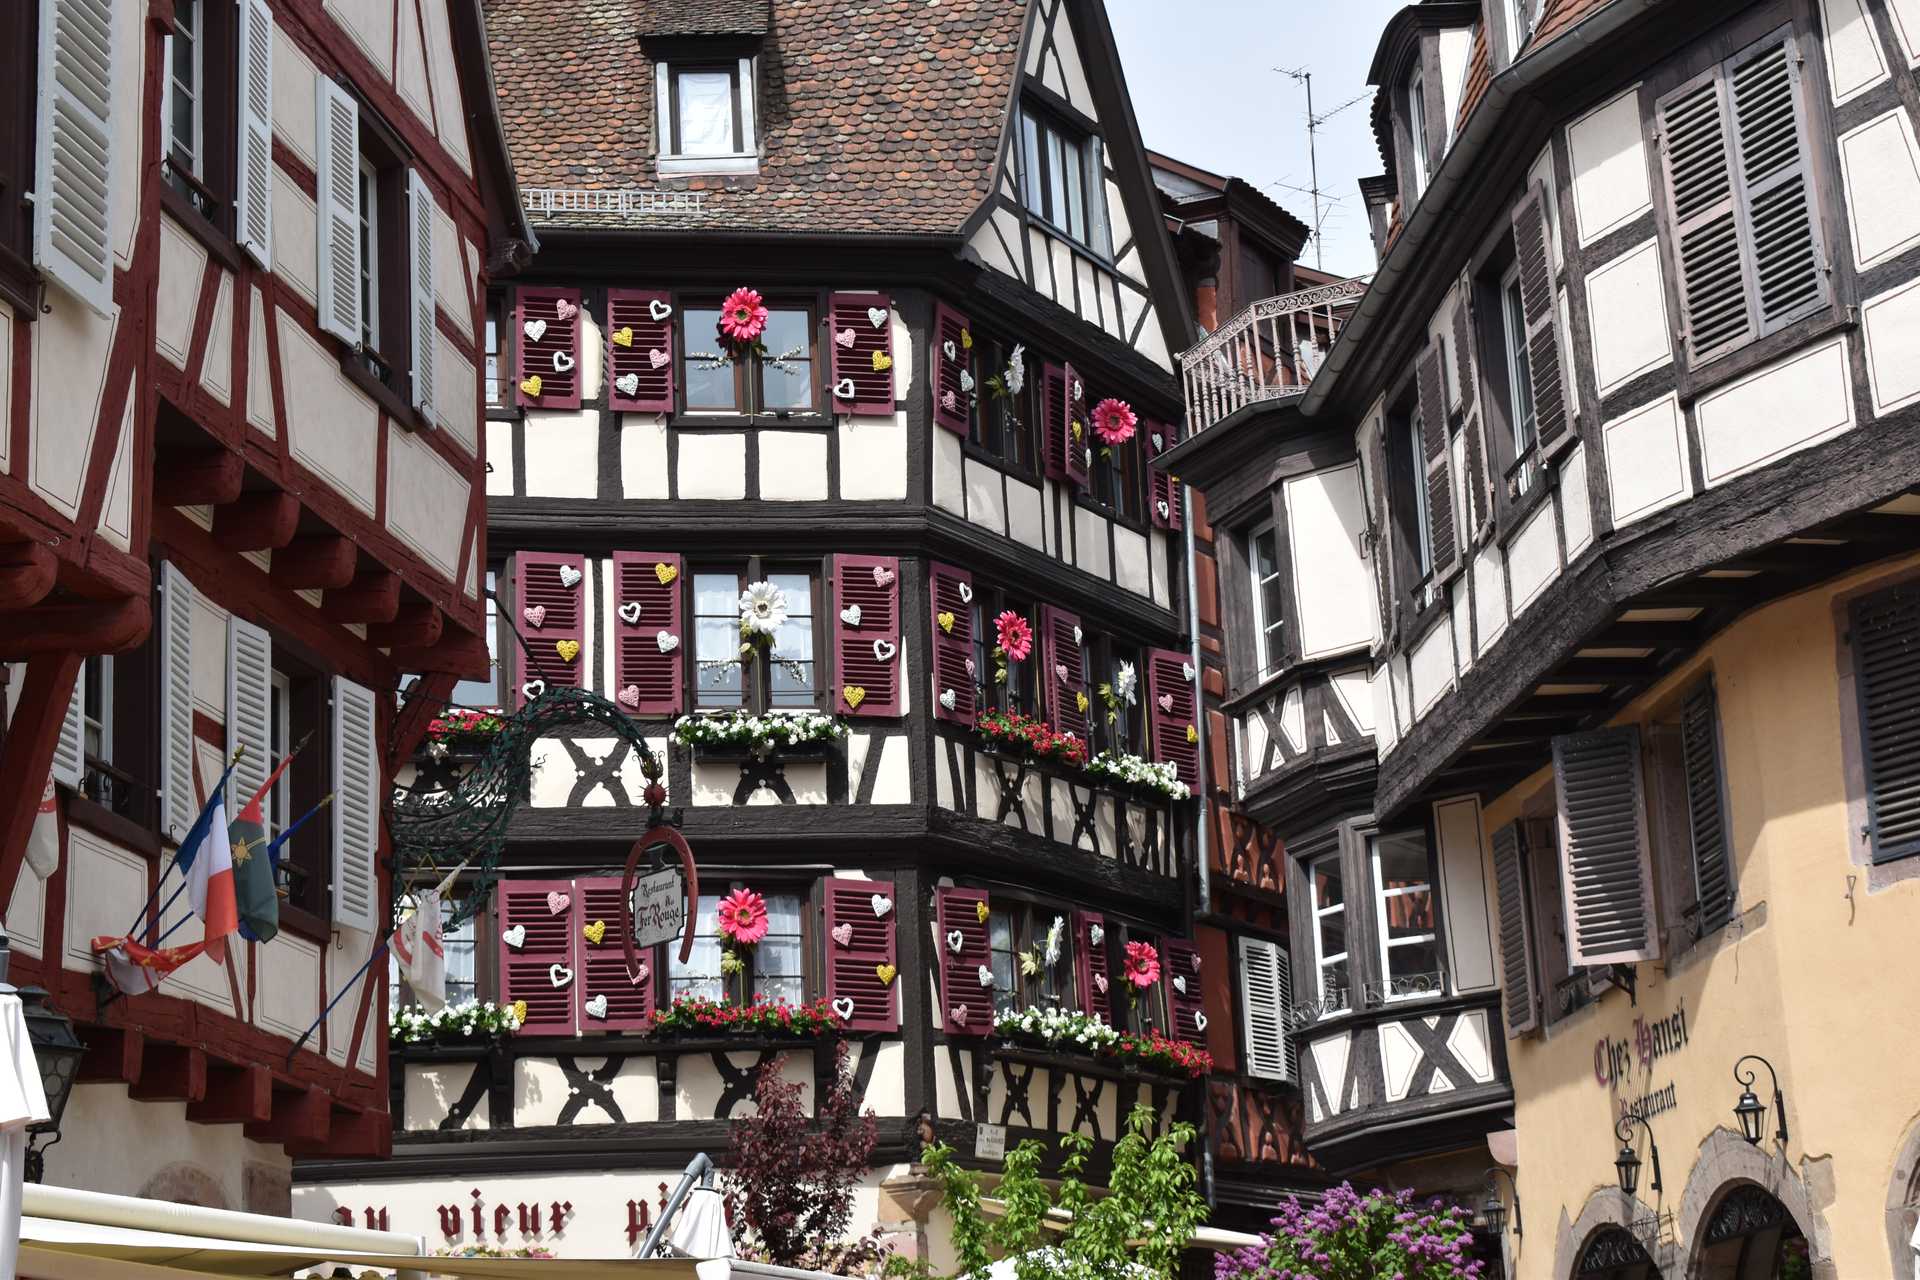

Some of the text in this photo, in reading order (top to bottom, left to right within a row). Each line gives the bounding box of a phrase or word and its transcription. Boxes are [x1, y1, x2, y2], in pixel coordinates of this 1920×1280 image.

[640, 875, 675, 898] Restaurant
[637, 903, 680, 929] Fer Rouge
[1593, 997, 1689, 1092] Chez Hansi
[1619, 1080, 1678, 1133] Restaurant
[436, 1188, 573, 1238] vieux
